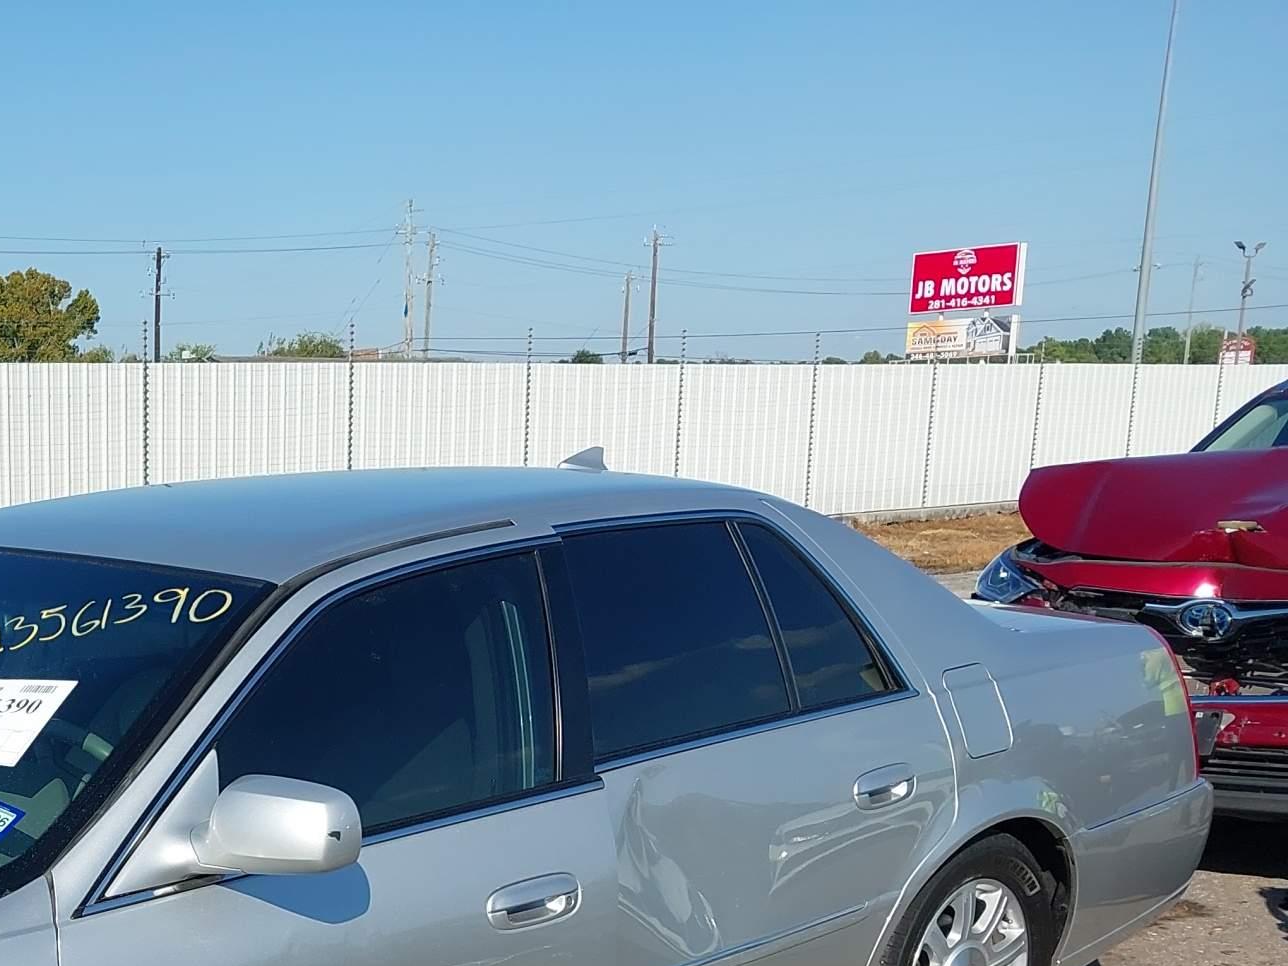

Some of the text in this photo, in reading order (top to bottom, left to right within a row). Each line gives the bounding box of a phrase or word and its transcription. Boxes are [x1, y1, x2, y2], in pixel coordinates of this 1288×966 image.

[915, 272, 1012, 299] JB MOTORS
[928, 295, 995, 310] 281-416-4341
